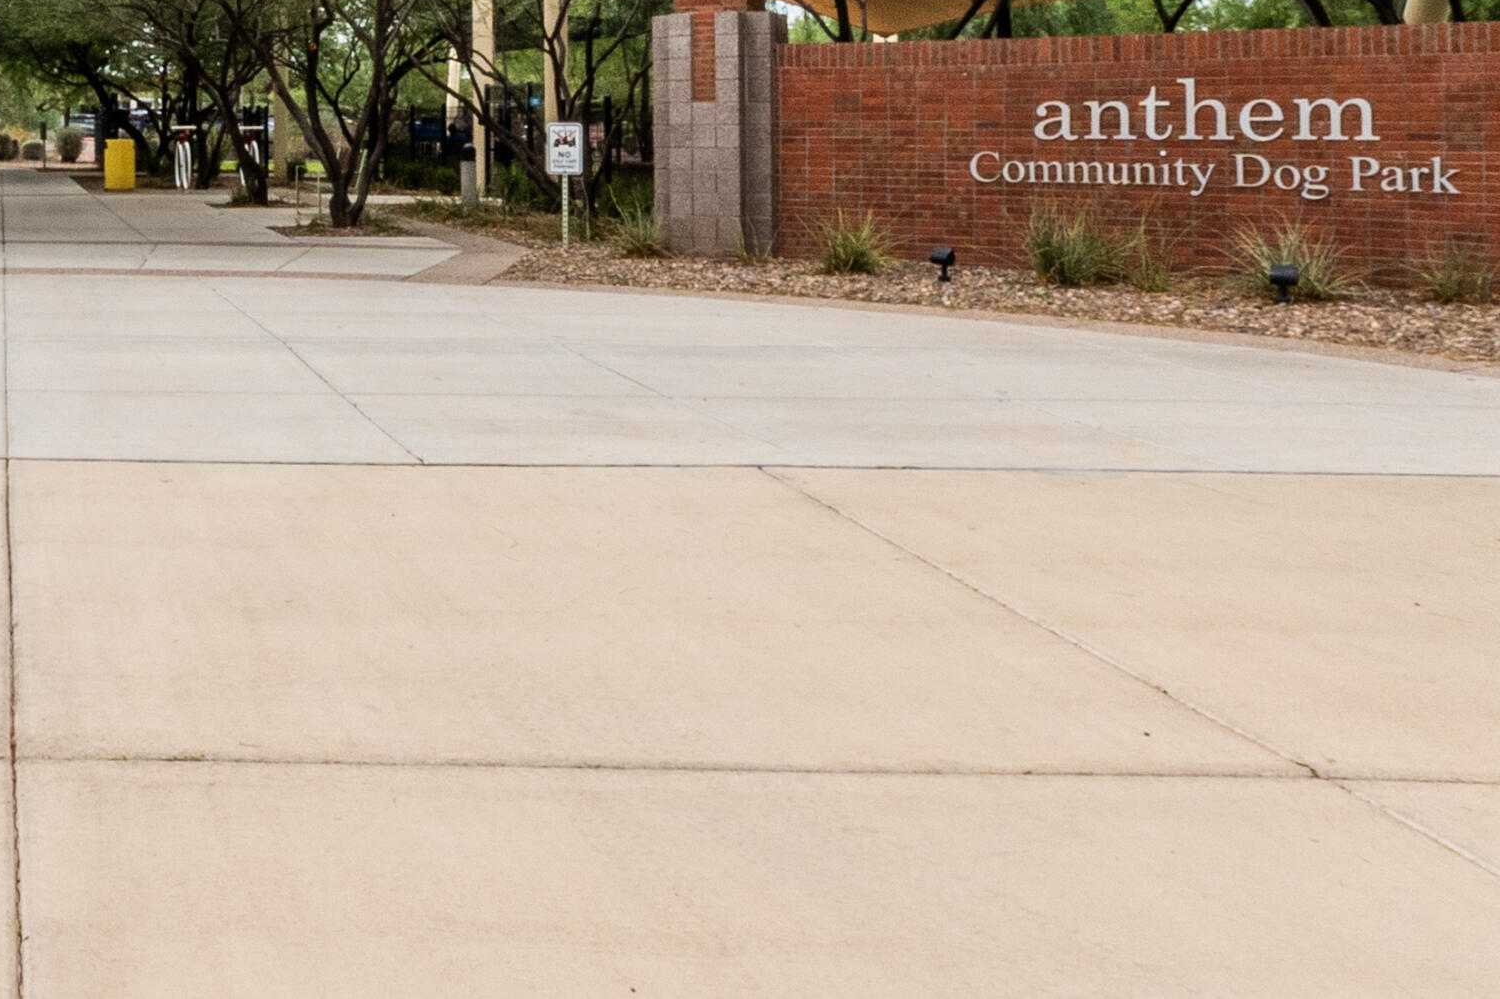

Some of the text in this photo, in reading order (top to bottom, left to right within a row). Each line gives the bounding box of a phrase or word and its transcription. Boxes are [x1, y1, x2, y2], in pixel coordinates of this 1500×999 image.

[1033, 77, 1382, 141] anthem
[557, 151, 571, 159] NO
[969, 149, 1461, 200] Community Dog Park
